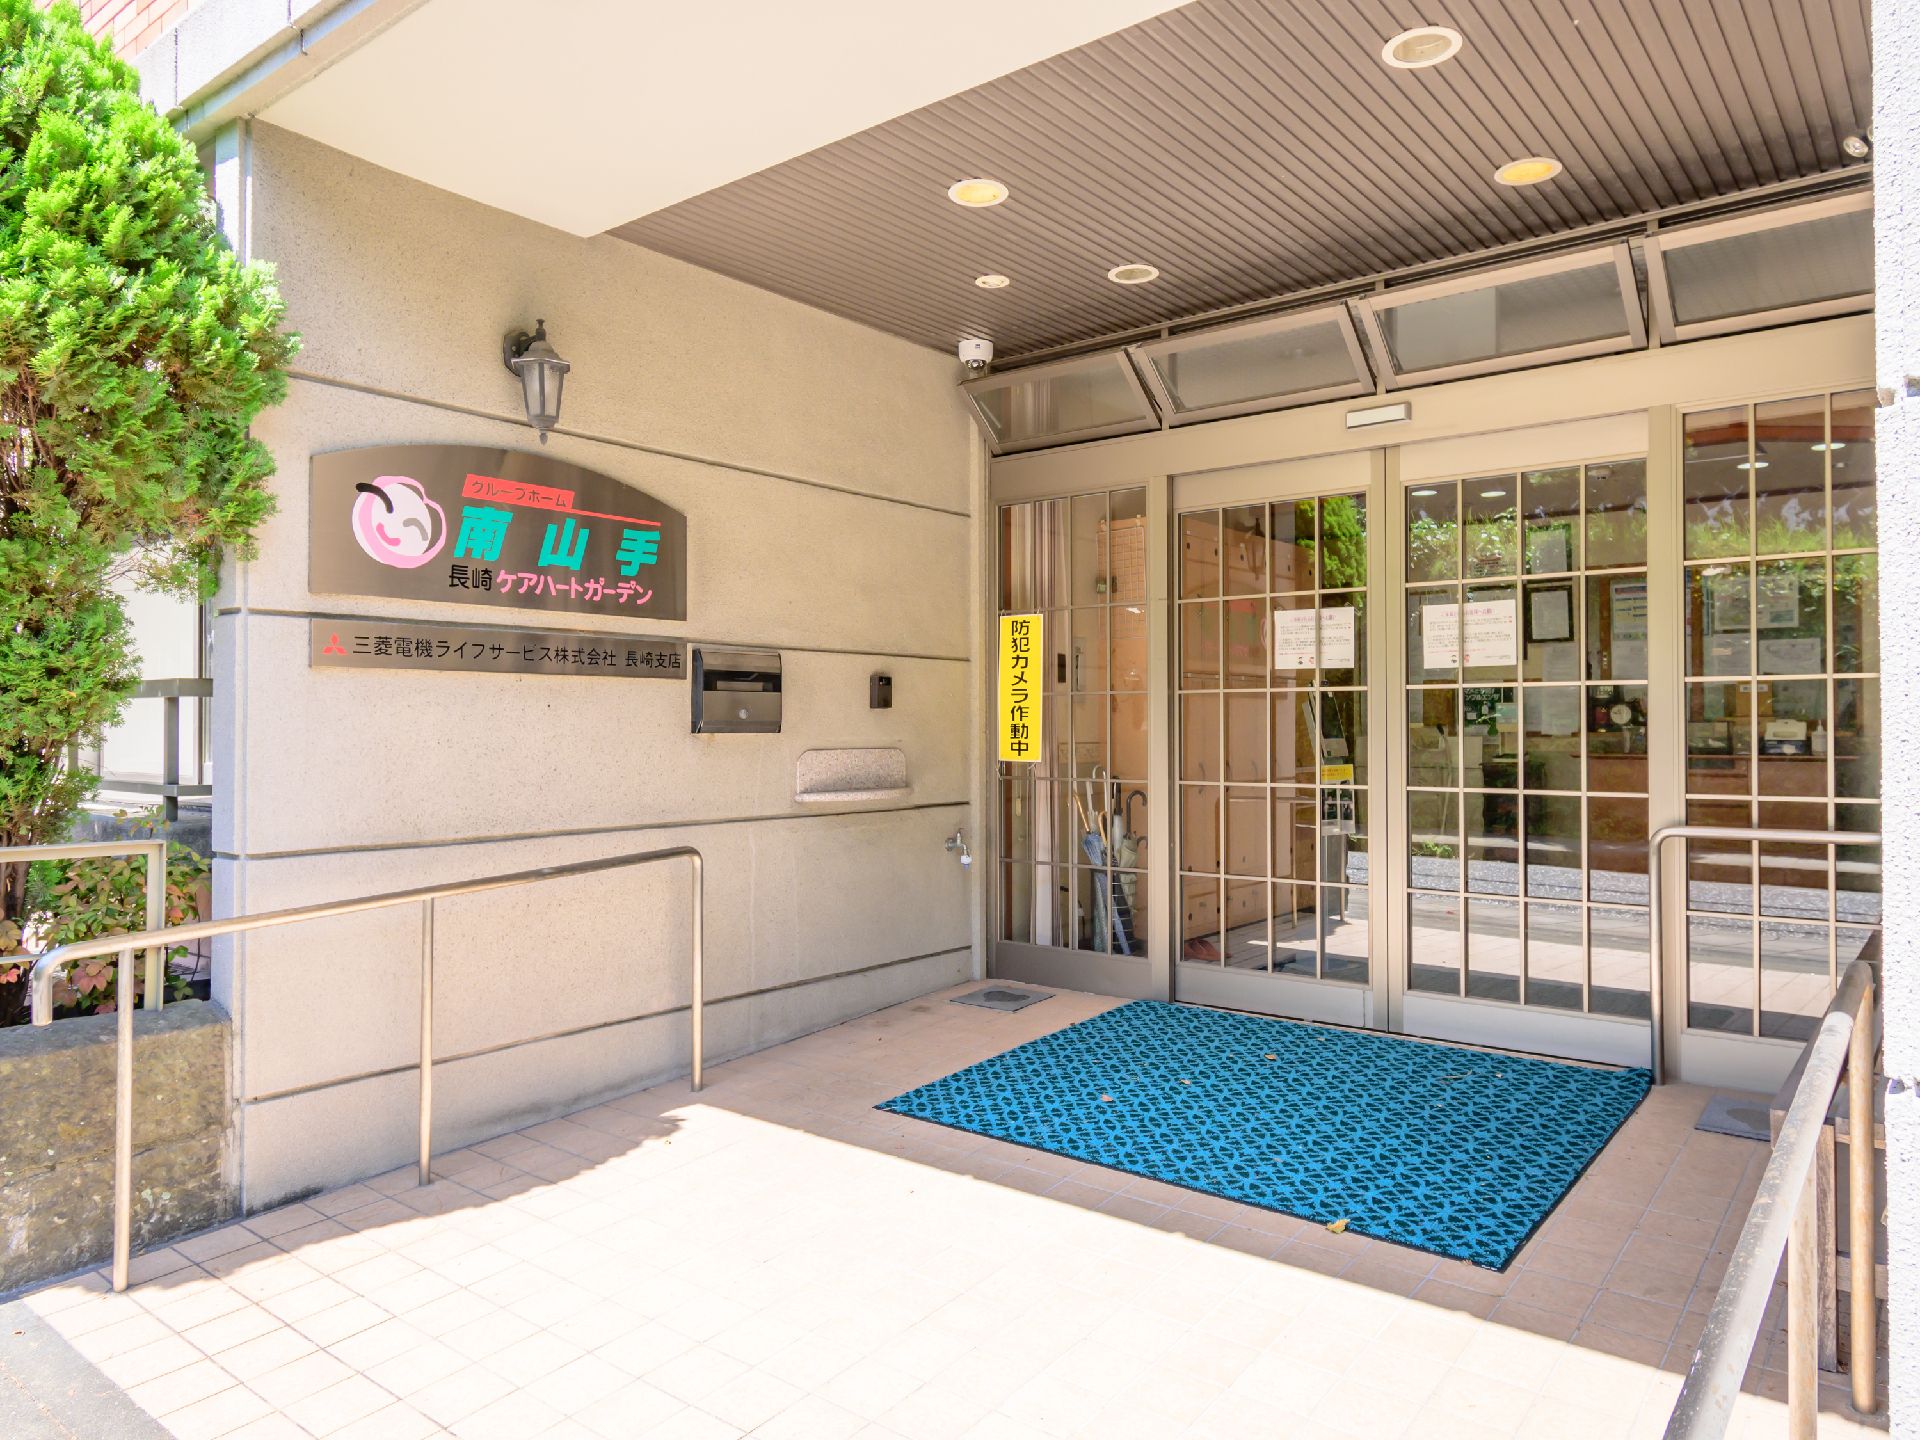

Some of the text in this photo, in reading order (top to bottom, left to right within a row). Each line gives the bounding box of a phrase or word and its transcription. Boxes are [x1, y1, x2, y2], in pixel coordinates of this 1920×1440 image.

[453, 505, 661, 577] 南山手
[352, 636, 681, 669] 三菱電機ライフサービス株式会社 長崎支店
[1010, 619, 1031, 757] 防犯カメラ作動中
